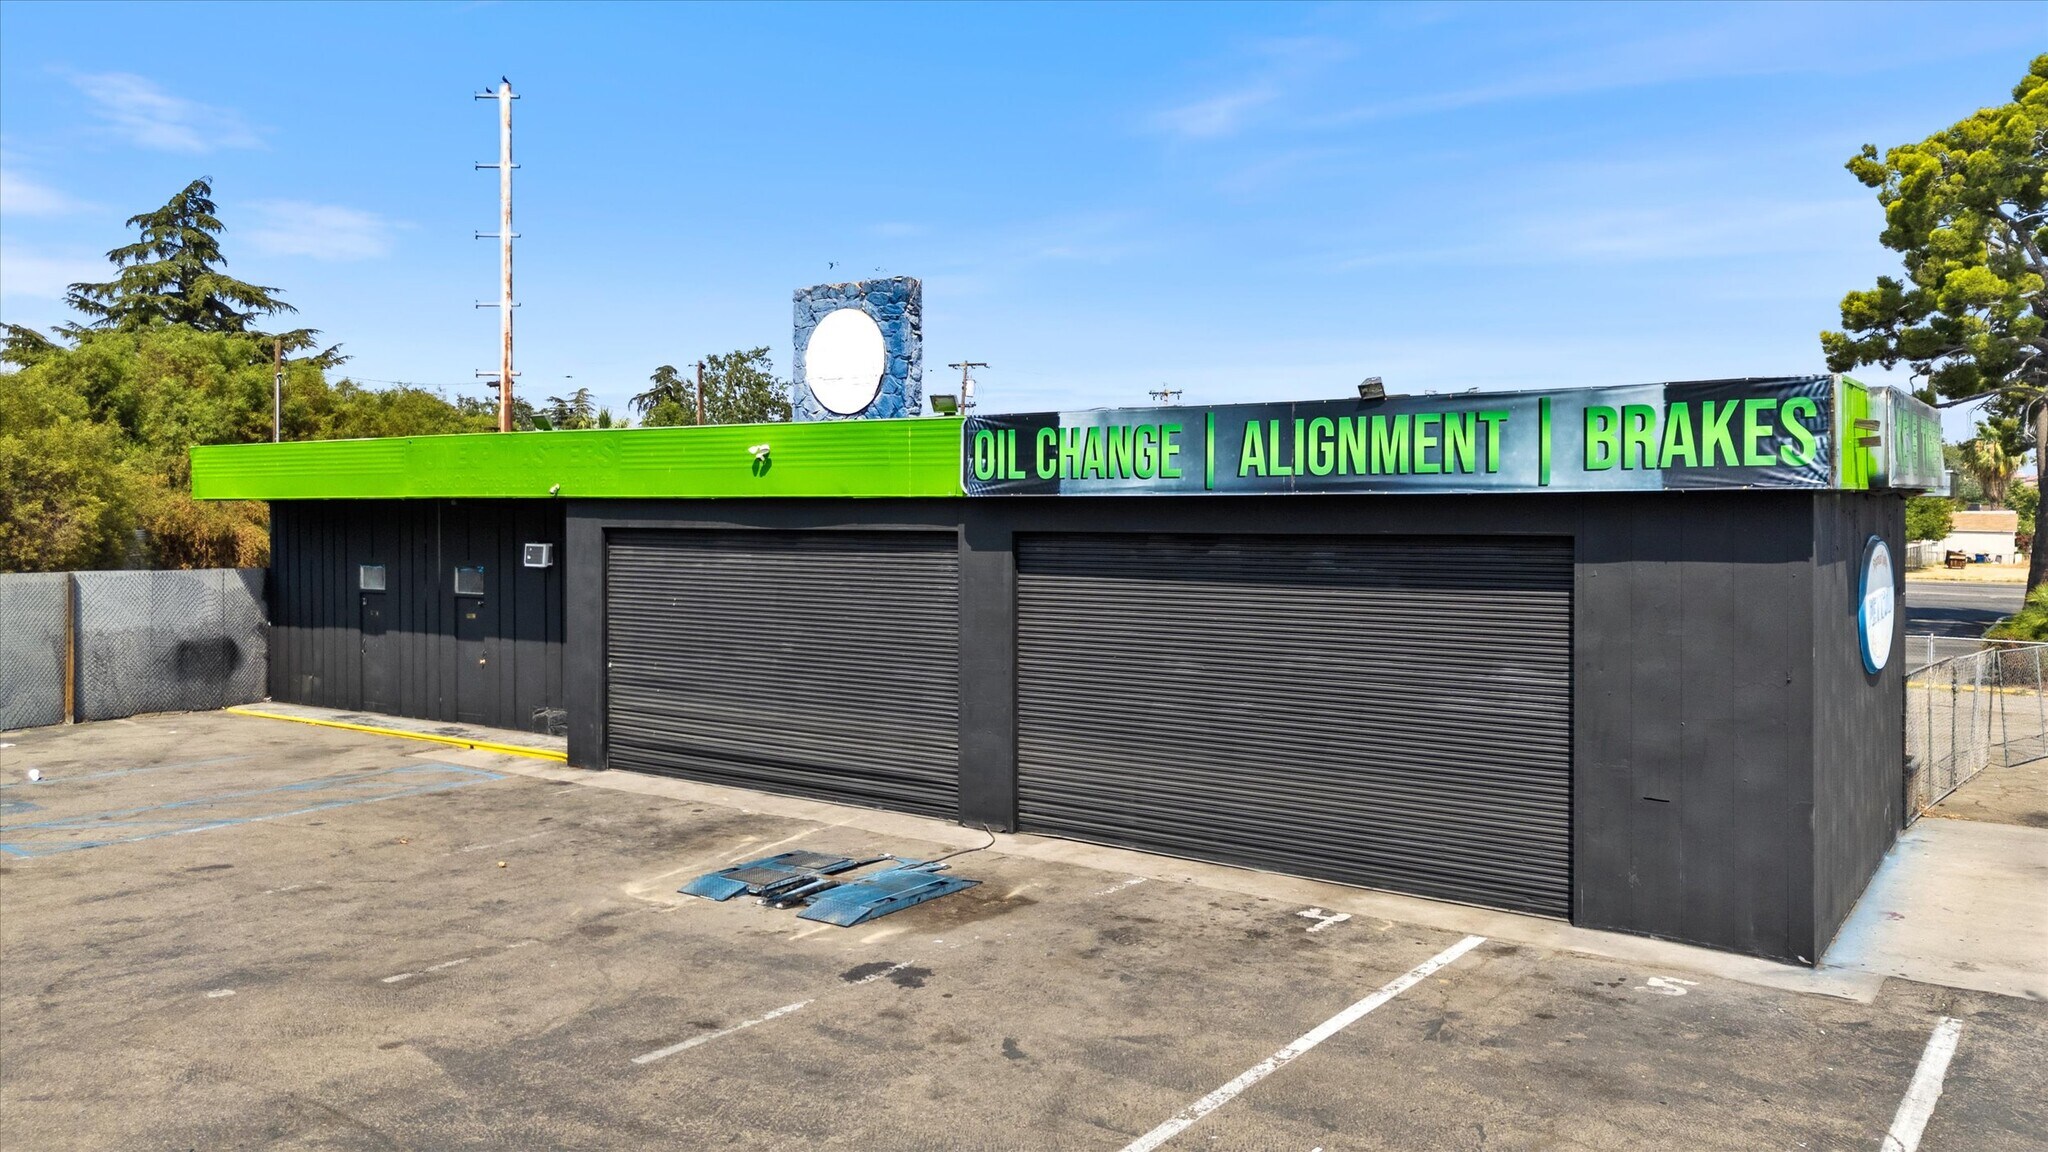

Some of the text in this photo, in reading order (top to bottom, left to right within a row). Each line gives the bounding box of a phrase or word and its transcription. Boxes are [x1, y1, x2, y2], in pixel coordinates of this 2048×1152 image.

[973, 397, 1818, 481] OIL CHANGE ALIGNMENT BRAKES
